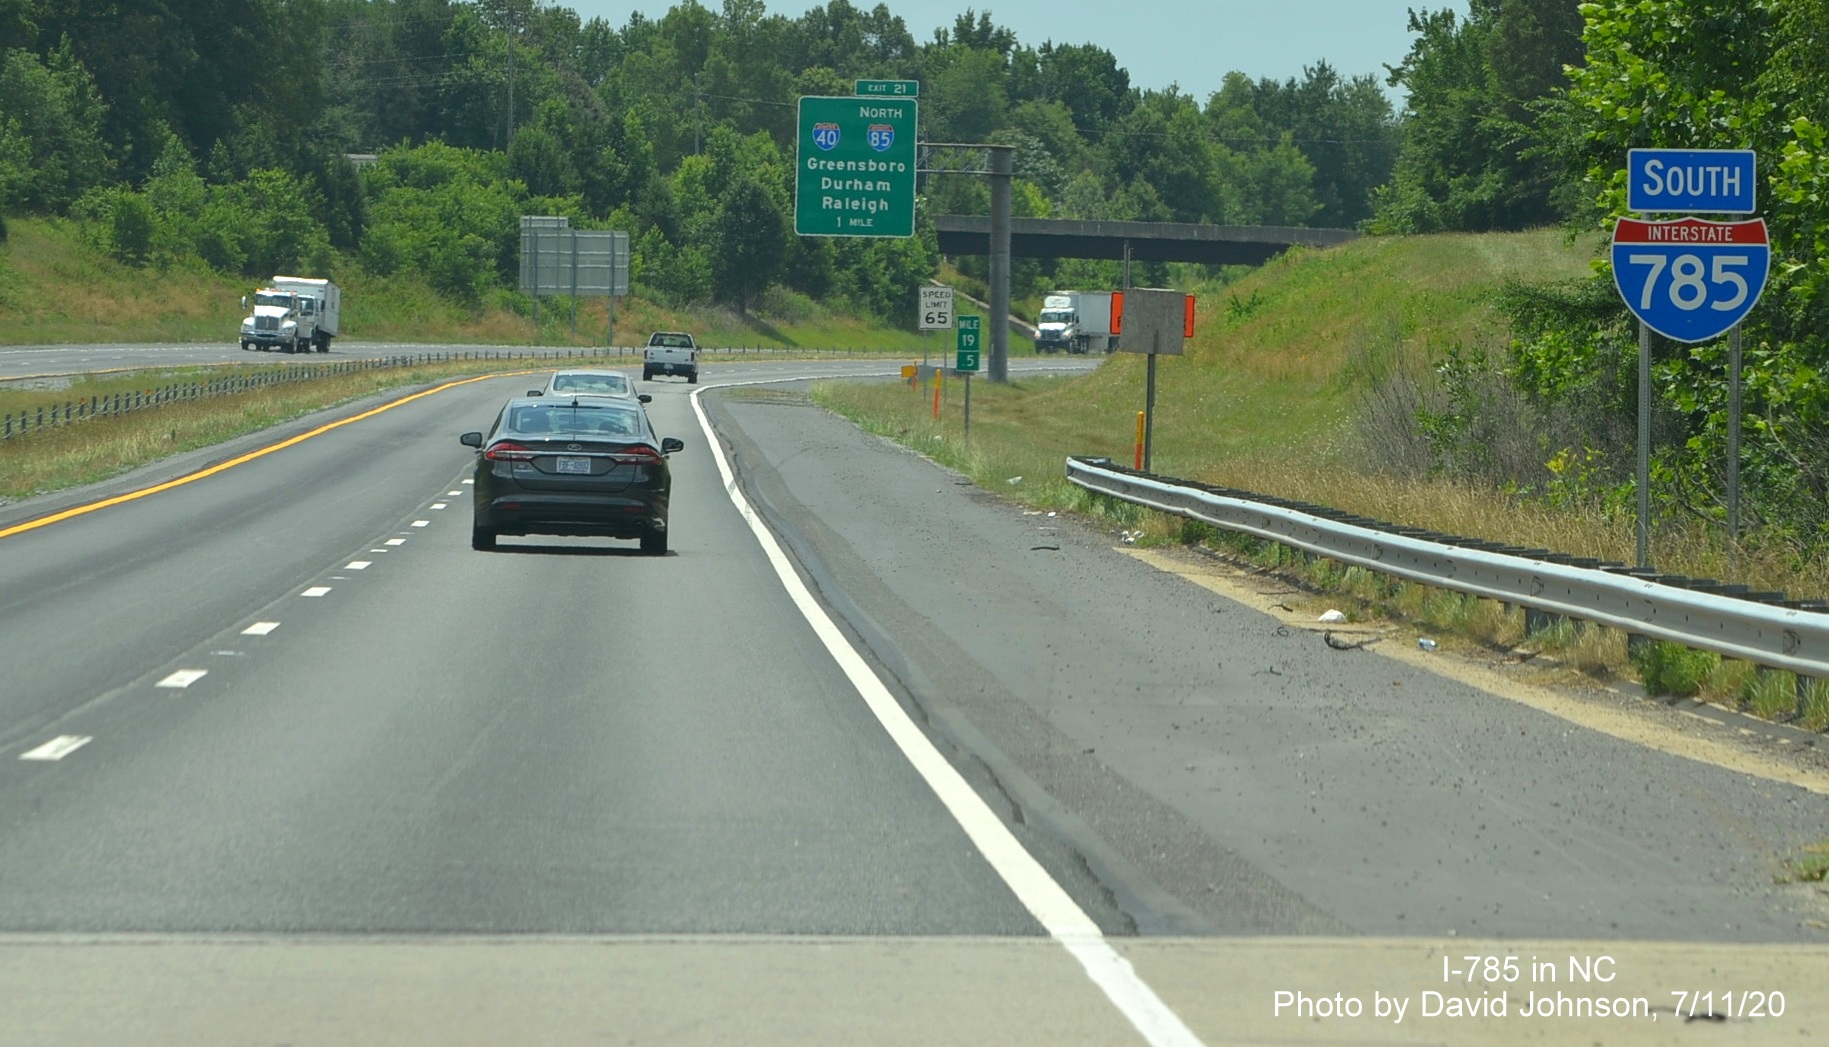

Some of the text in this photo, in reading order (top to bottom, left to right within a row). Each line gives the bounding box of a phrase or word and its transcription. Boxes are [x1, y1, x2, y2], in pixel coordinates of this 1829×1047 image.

[893, 85, 906, 94] 21
[859, 107, 902, 118] NORTH
[816, 131, 836, 146] 40
[870, 132, 890, 147] 85
[807, 157, 906, 172] Greensboro
[821, 177, 891, 191] Durham
[1643, 159, 1740, 196] SOUTH
[822, 196, 889, 214] Raleigh
[836, 217, 874, 227] 1 MILE
[1648, 226, 1733, 241] INTERSTATE
[1629, 254, 1749, 311] 785
[925, 312, 948, 324] 65
[959, 320, 979, 329] MILE
[962, 334, 975, 346] 19
